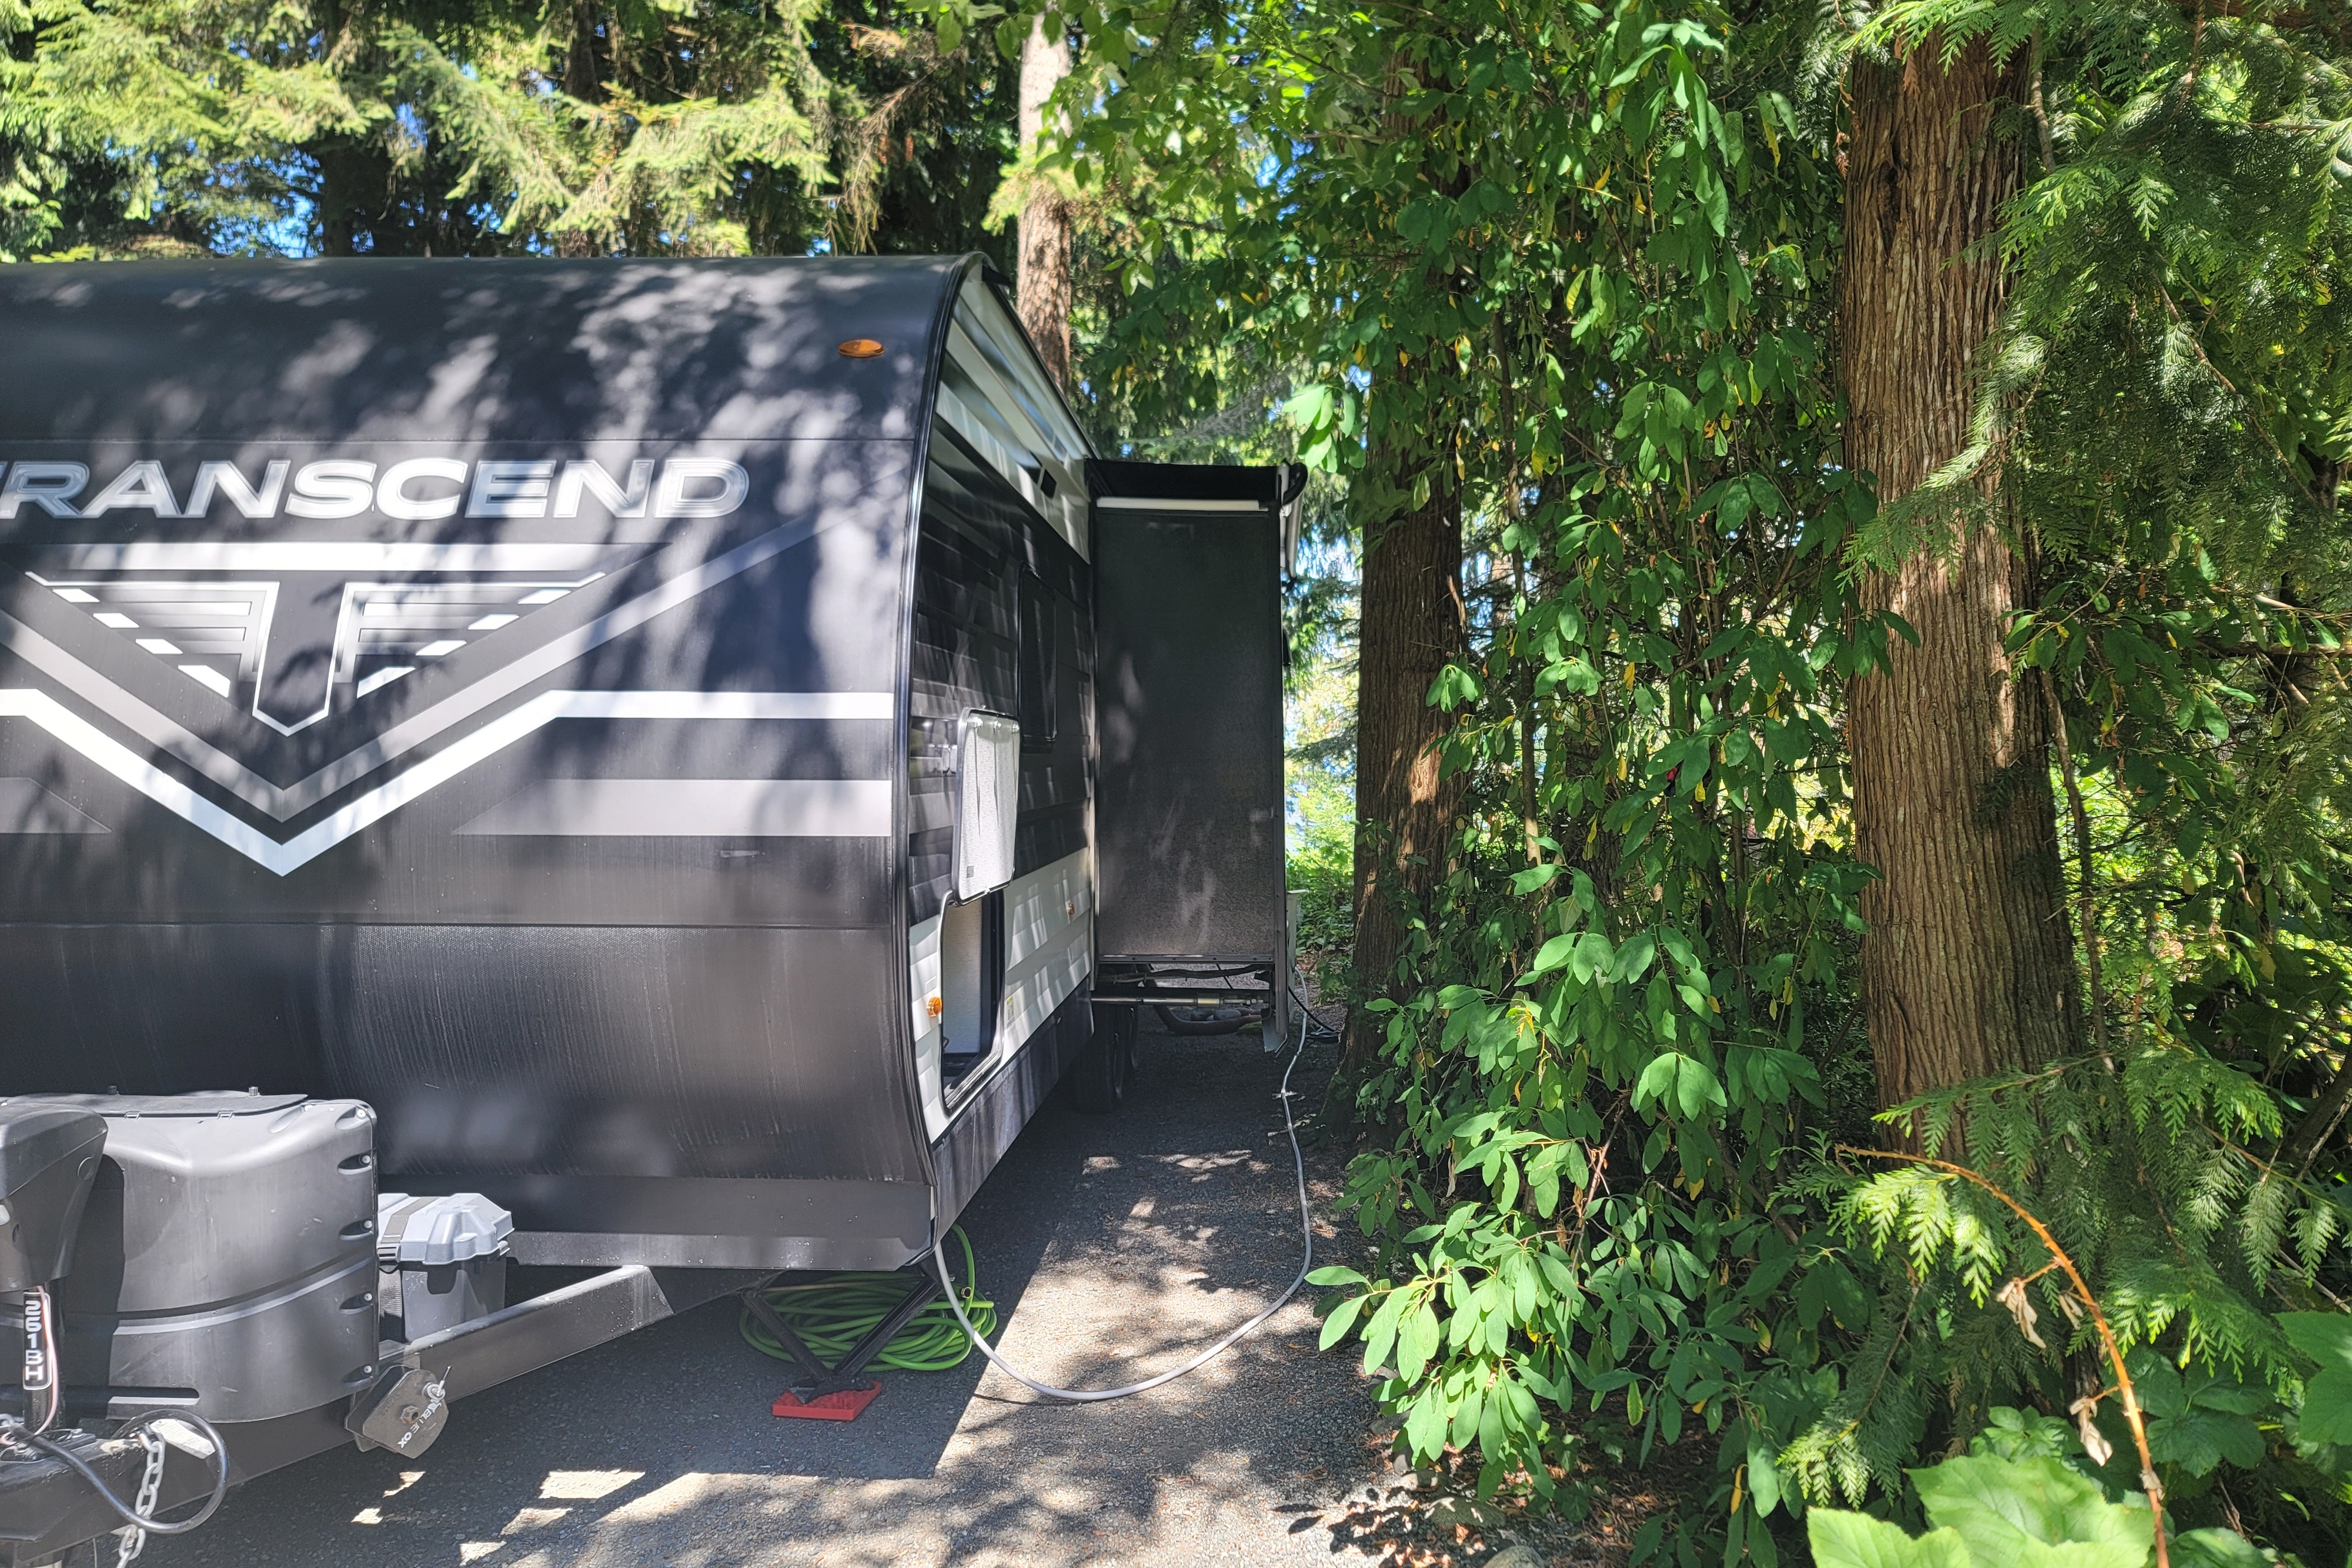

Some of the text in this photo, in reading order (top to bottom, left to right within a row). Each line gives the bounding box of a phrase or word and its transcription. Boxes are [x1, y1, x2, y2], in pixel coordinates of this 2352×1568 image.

[0, 458, 750, 520] RANSCEND
[25, 1300, 44, 1381] 261BH
[397, 1410, 432, 1448] BLUE OX
